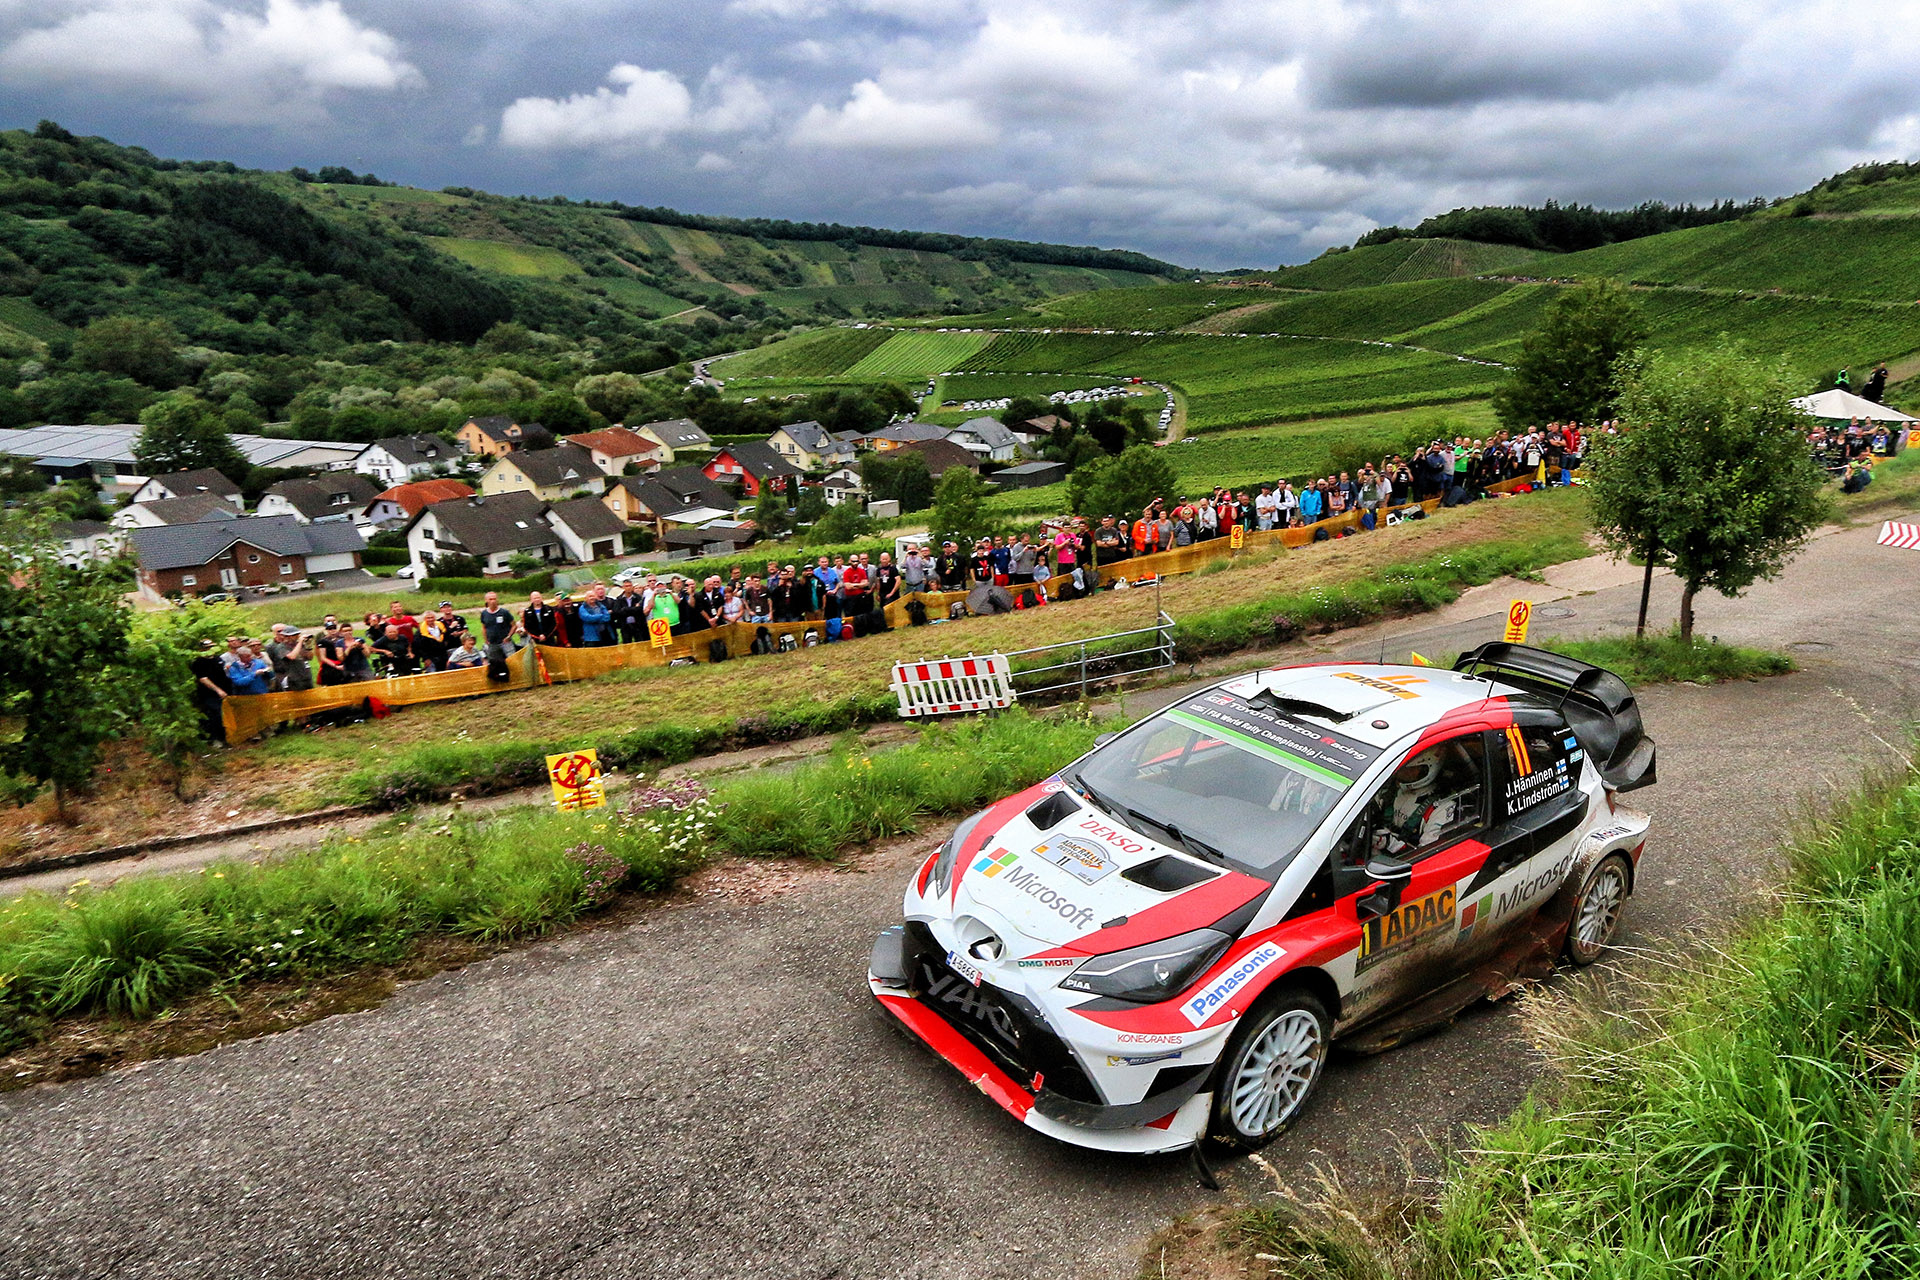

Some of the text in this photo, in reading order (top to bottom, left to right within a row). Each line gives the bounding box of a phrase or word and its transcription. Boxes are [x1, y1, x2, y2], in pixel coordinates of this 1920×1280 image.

[1207, 709, 1222, 718] FIA
[1220, 714, 1244, 727] World
[1240, 722, 1263, 735] Rally
[1261, 730, 1316, 756] Championship
[1230, 702, 1275, 721] TOYOTA
[1275, 719, 1321, 740] GAZOO
[1320, 736, 1368, 760] Racing
[1505, 723, 1532, 777] 11
[1505, 767, 1554, 799] J.Hänninen
[1507, 782, 1560, 816] K.Lindström
[1079, 820, 1143, 853] DENSO
[1056, 856, 1071, 866] 11
[1060, 840, 1106, 867] ADAC RALLYE
[1003, 865, 1094, 930] Microsoft
[1386, 889, 1453, 946] ADAC
[1018, 959, 1074, 968] DMG MORI
[1066, 979, 1091, 990] PIAA
[1190, 947, 1277, 1017] Panasonic
[1117, 1033, 1183, 1045] KONECRANES
